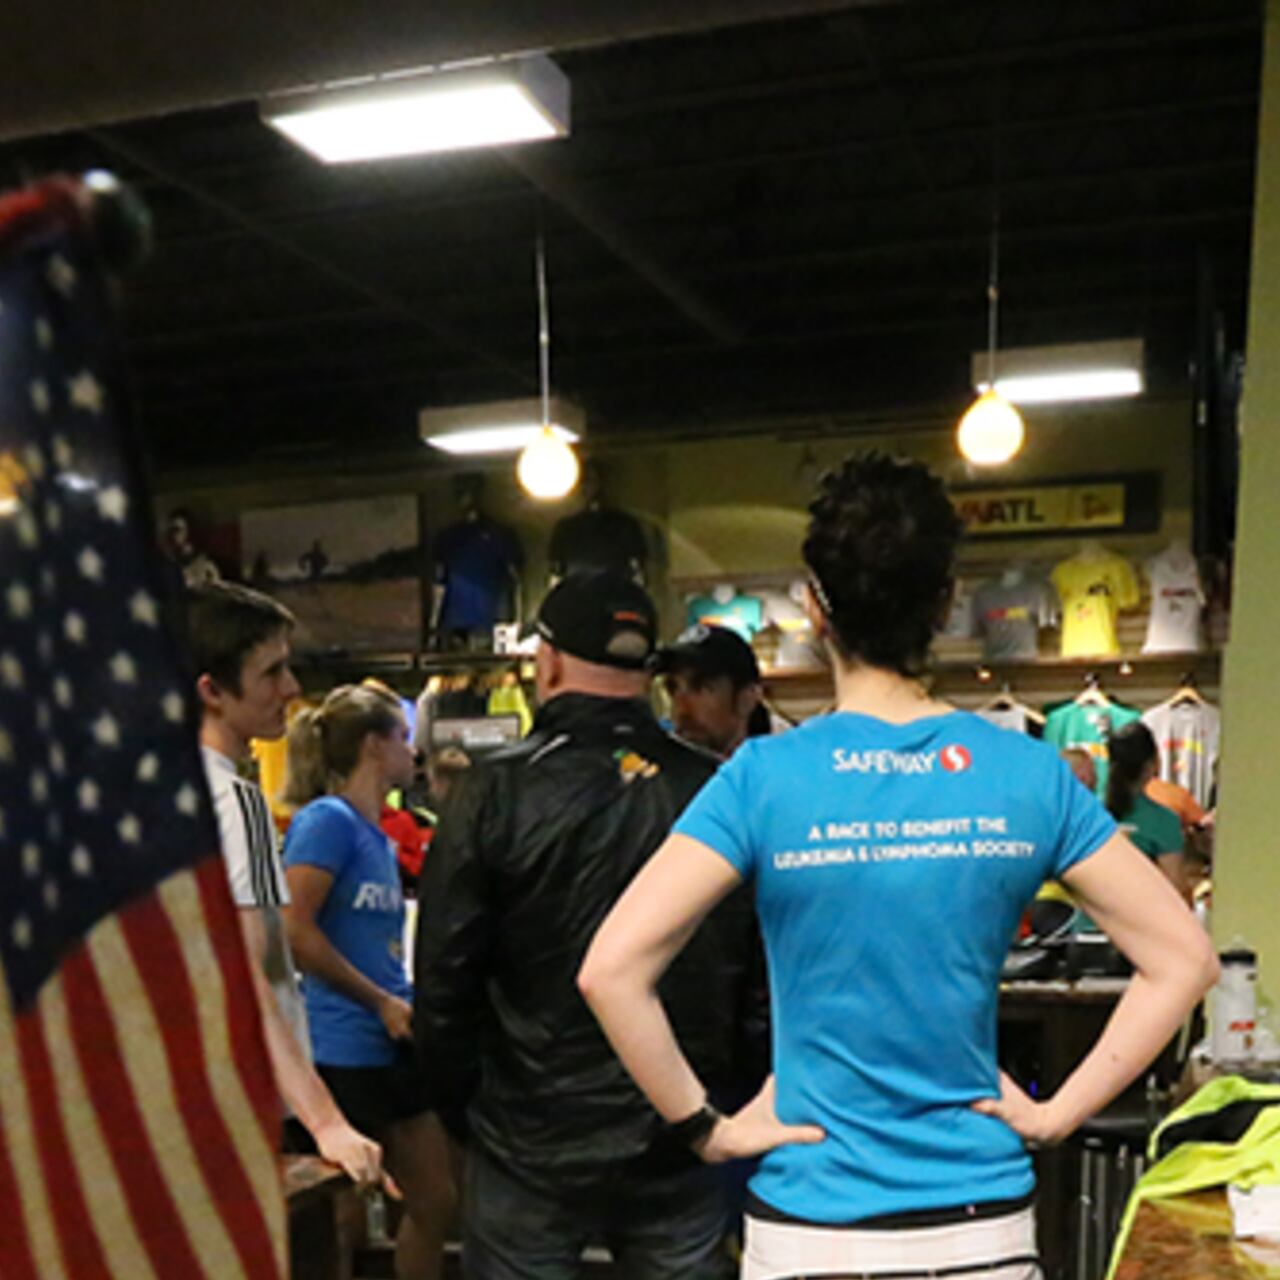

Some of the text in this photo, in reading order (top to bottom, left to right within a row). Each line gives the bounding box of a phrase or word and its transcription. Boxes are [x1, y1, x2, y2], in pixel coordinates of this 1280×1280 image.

[832, 749, 938, 775] SAFEWAY
[808, 816, 1007, 841] A RACE TO BENEFIT THE
[970, 841, 1036, 859] SOCIETY
